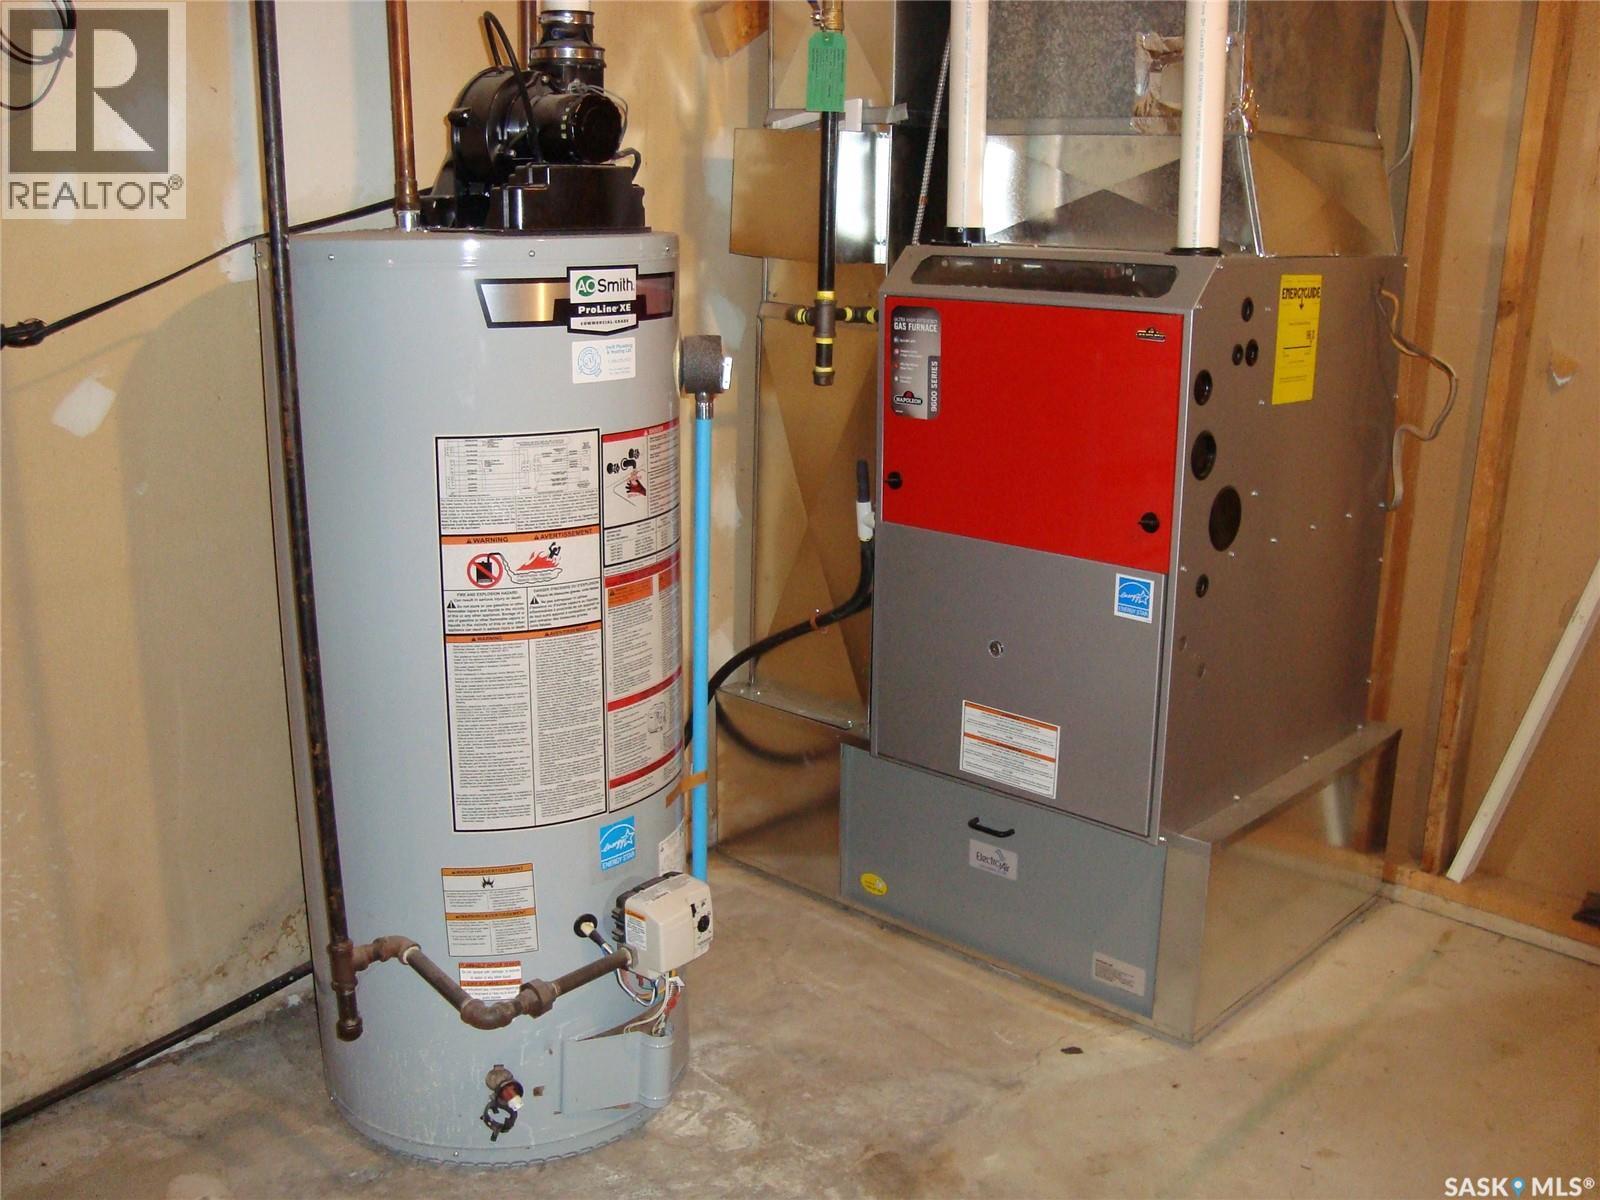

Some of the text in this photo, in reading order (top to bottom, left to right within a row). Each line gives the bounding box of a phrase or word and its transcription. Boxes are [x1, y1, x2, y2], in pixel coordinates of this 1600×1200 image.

[619, 303, 631, 313] XE
[893, 321, 938, 333] GAS FURNACE
[930, 361, 938, 389] SERIES
[540, 527, 593, 540] AVERTISSEMENT
[472, 536, 508, 544] WARNING
